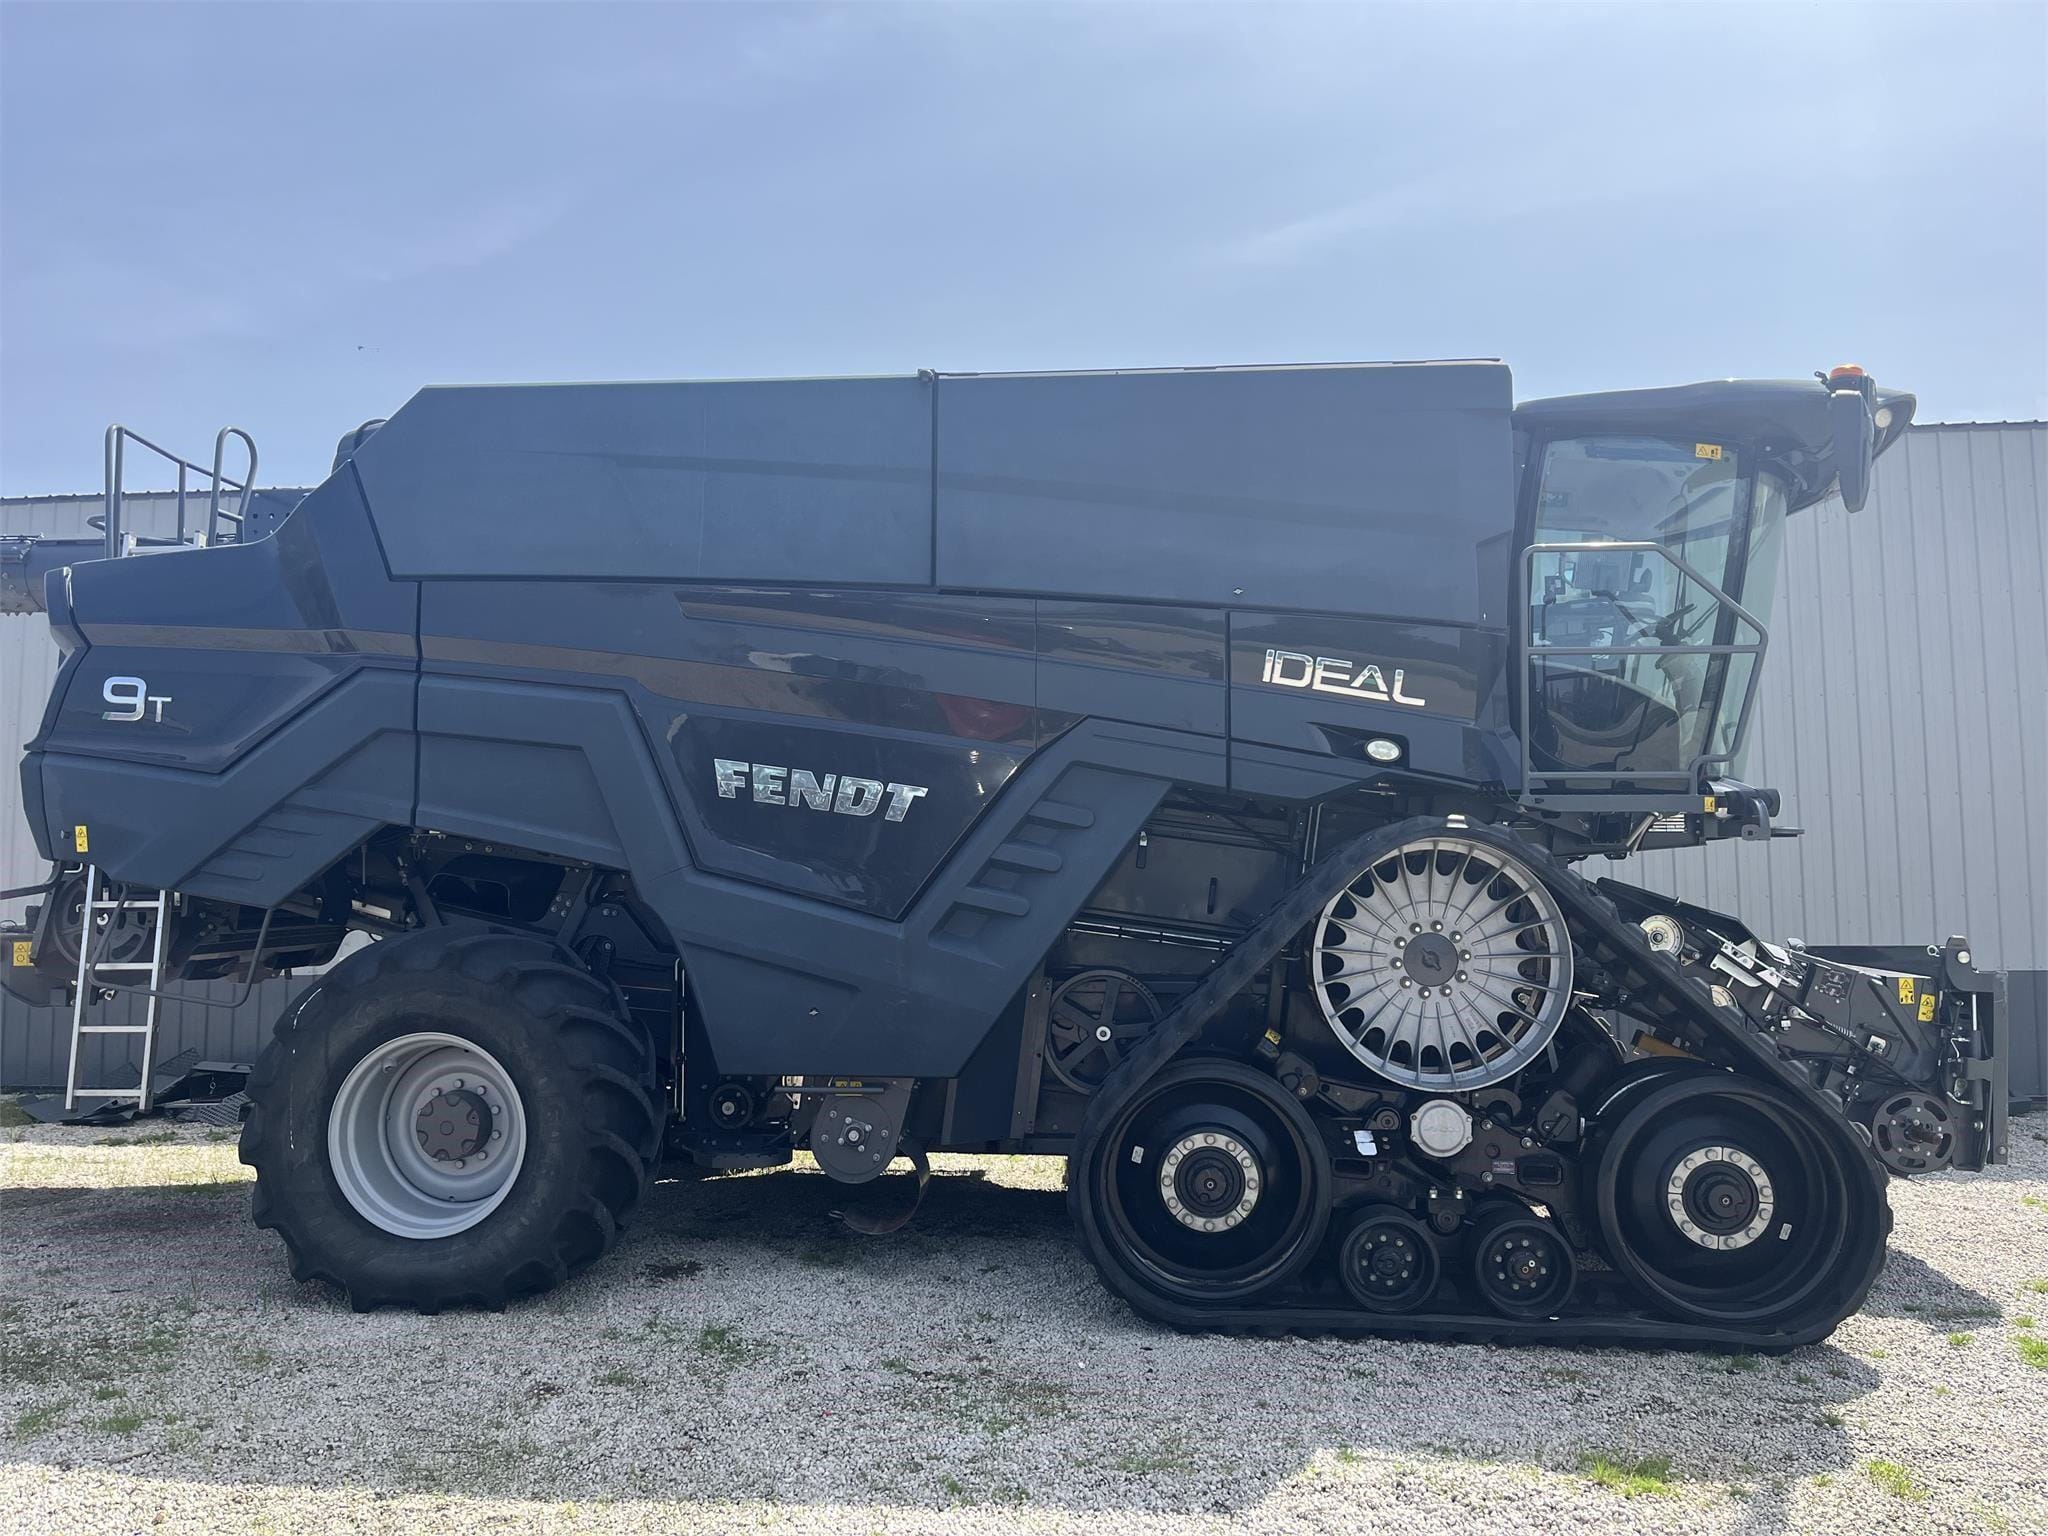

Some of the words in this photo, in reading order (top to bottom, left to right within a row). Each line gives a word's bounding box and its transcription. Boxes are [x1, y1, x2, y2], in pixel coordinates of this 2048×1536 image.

[102, 676, 172, 722] 9T
[1262, 649, 1425, 706] IDEAL
[714, 758, 929, 823] FENDT
